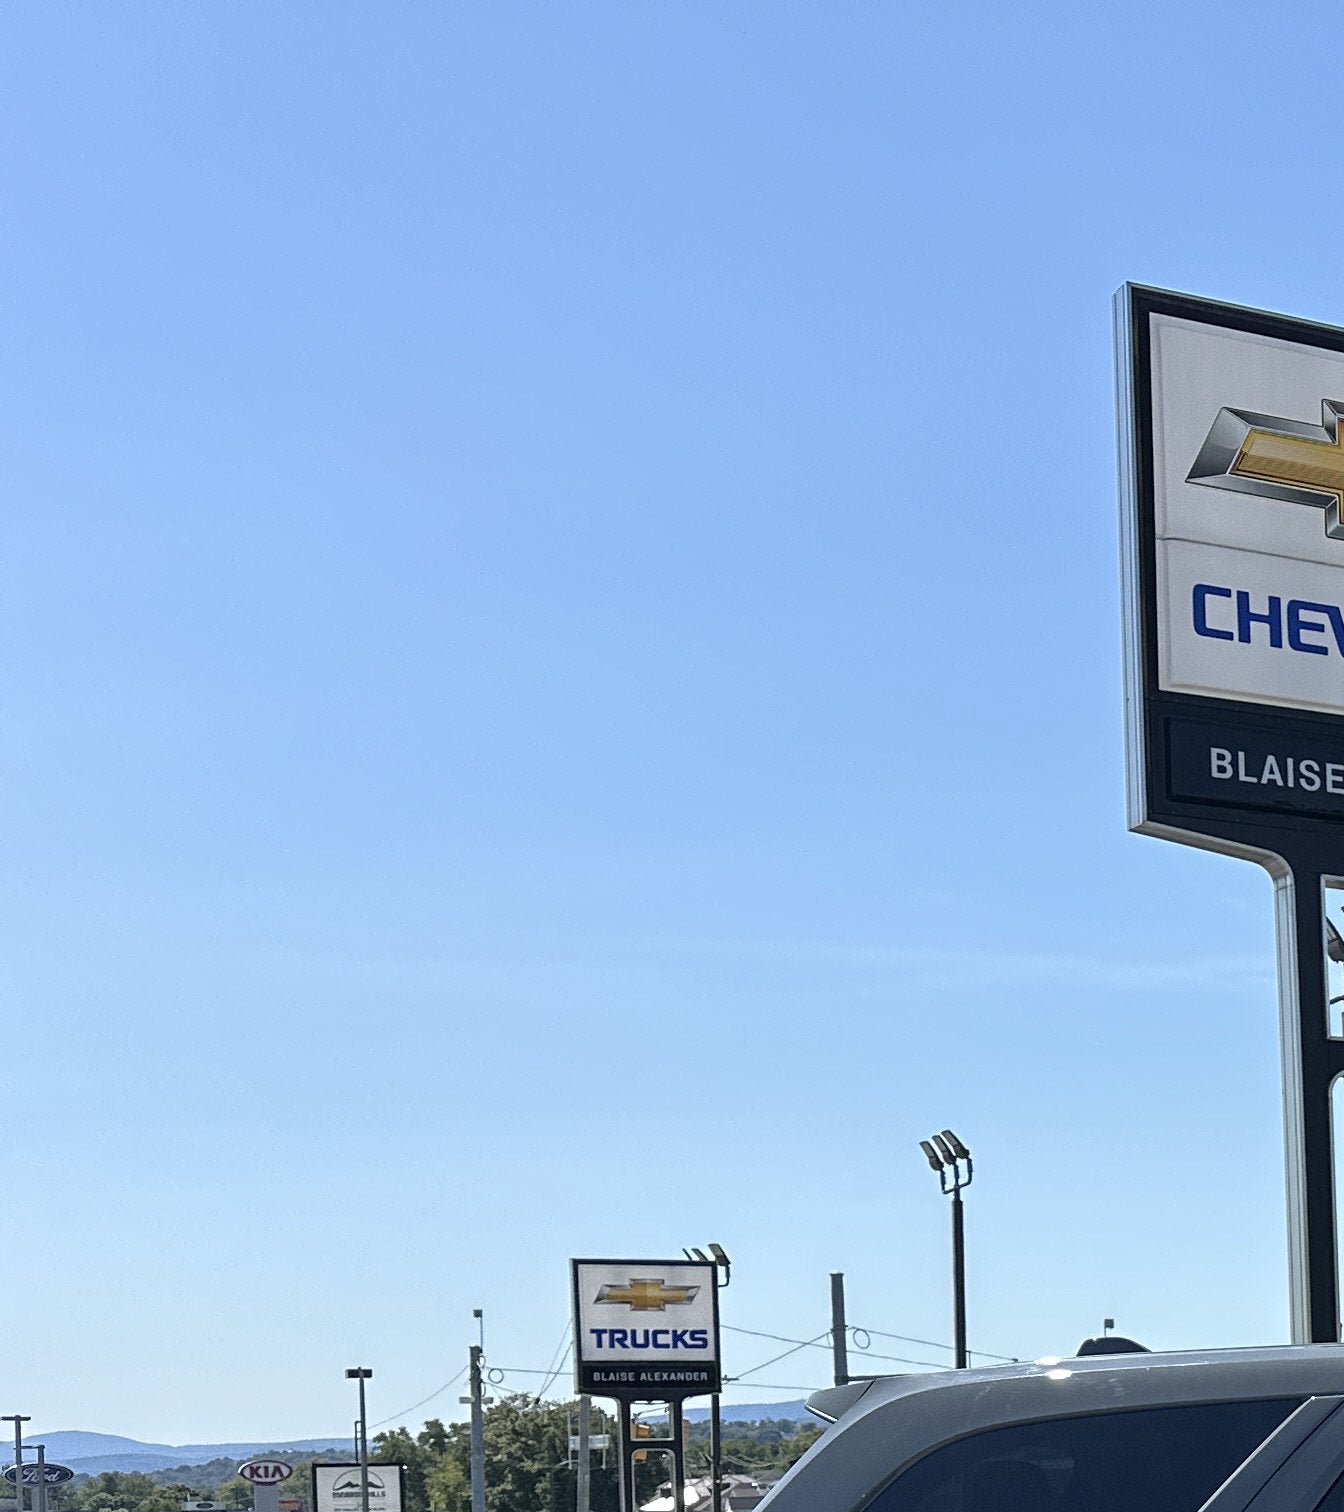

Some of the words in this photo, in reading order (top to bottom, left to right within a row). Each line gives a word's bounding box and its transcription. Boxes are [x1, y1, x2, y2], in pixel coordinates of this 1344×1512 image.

[591, 1329, 708, 1349] TRUCKS
[593, 1372, 635, 1381] BLAISE
[639, 1371, 708, 1381] ALEXANDER
[249, 1465, 285, 1479] KIA
